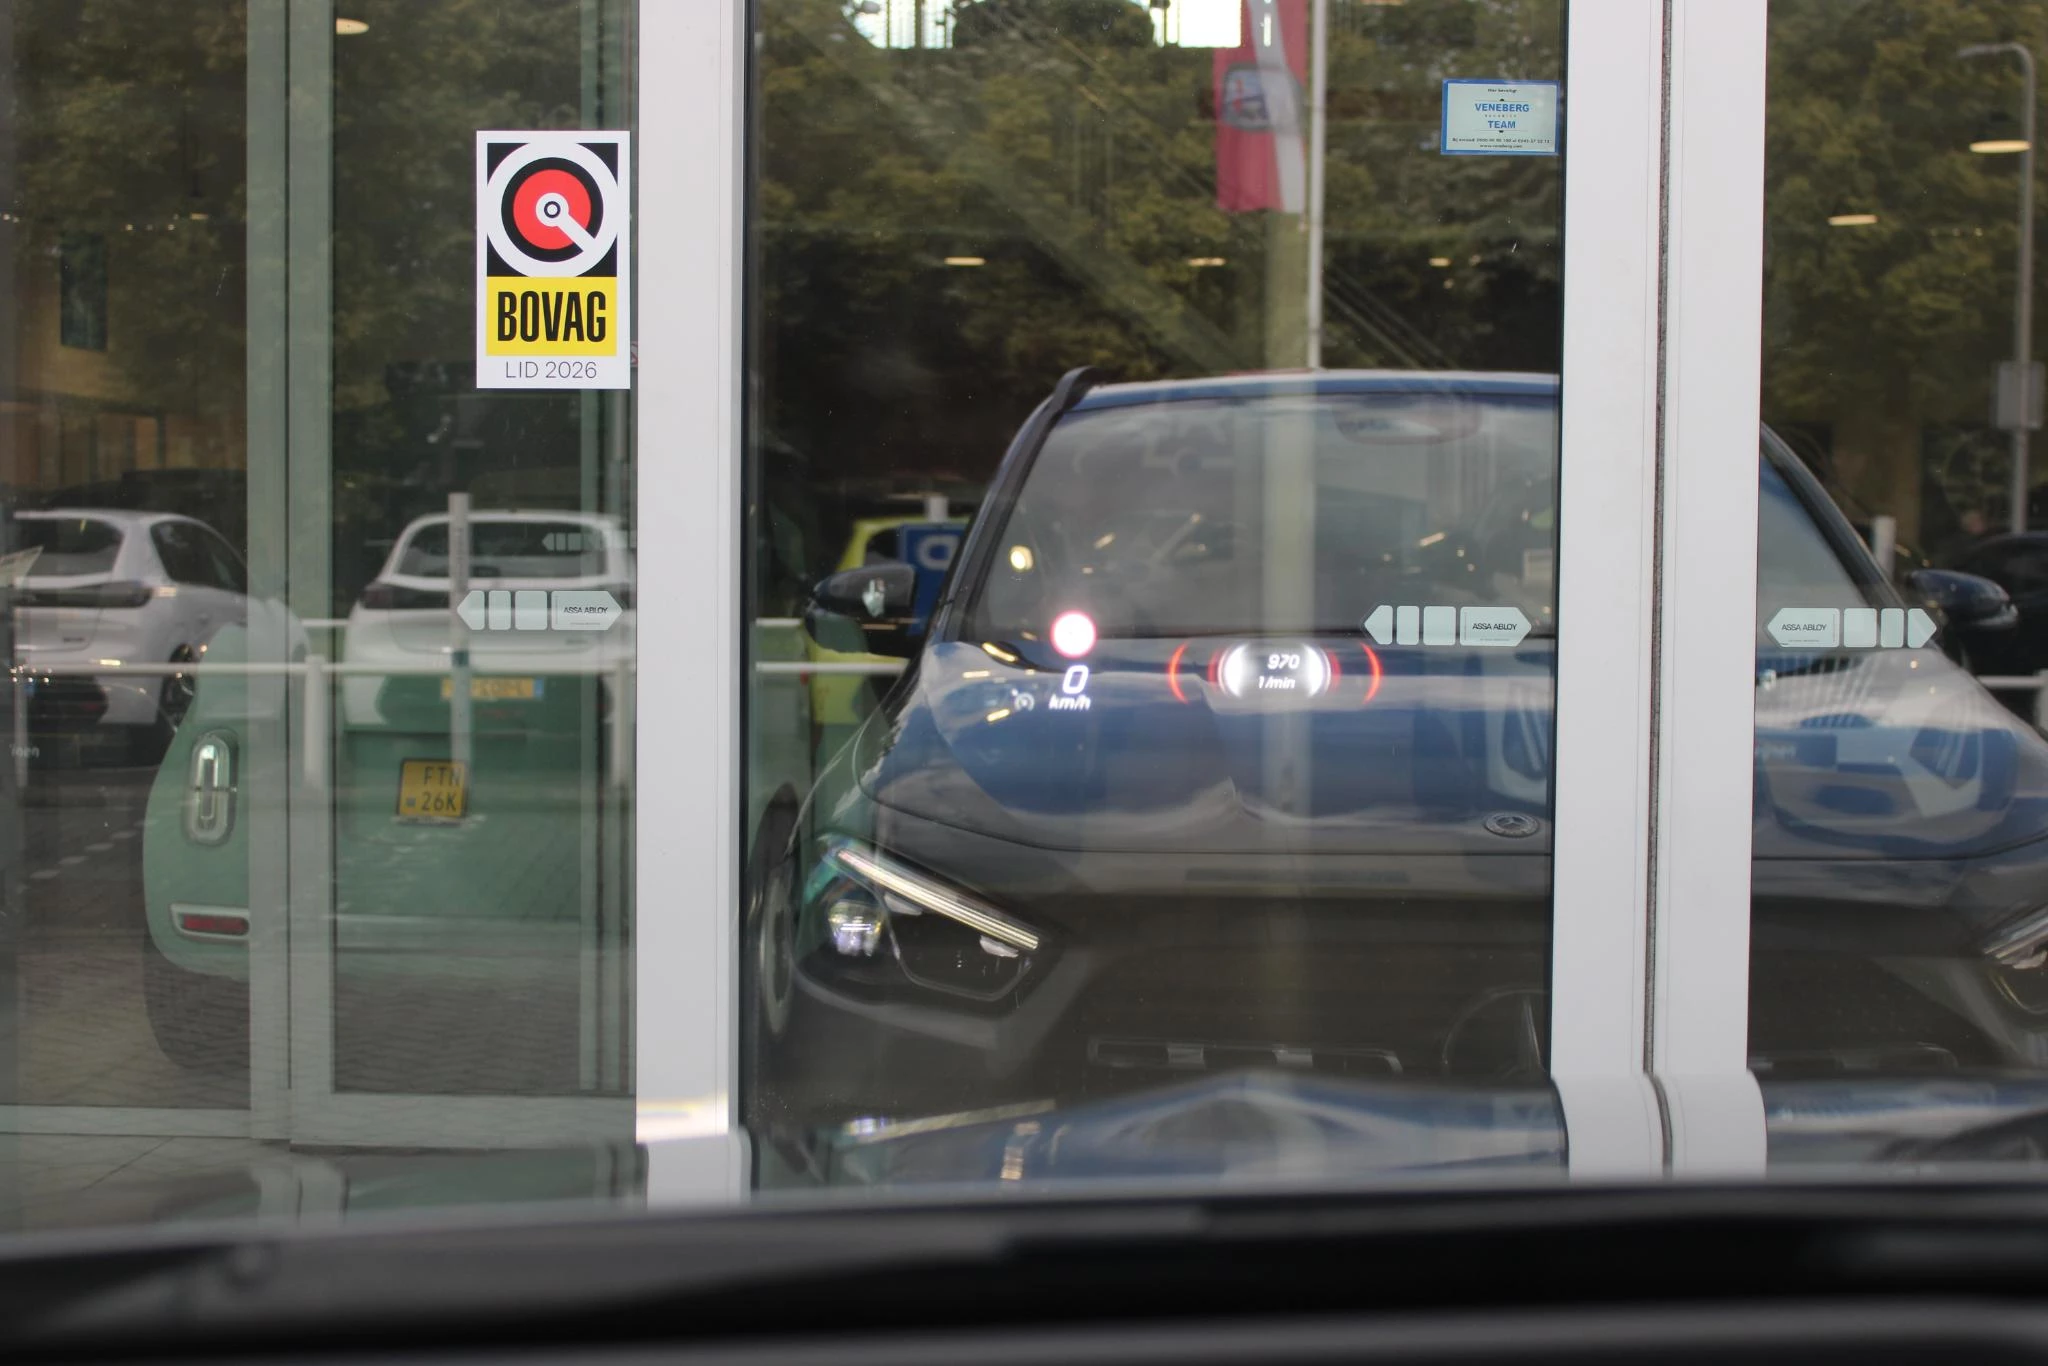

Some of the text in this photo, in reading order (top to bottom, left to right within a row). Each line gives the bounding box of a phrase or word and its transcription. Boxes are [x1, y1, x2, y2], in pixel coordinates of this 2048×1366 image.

[1475, 103, 1530, 113] VENEBERG
[1488, 120, 1516, 129] TEAM
[497, 290, 606, 343] BOVAG
[505, 361, 597, 379] LID 2026
[563, 606, 608, 614] ASSA ABLOY
[1472, 622, 1517, 631] ASSA ABLOY
[1781, 623, 1827, 631] ASSA ABLOY
[1267, 653, 1301, 670] 970
[1062, 664, 1090, 695] 0
[1048, 693, 1091, 711] km/h
